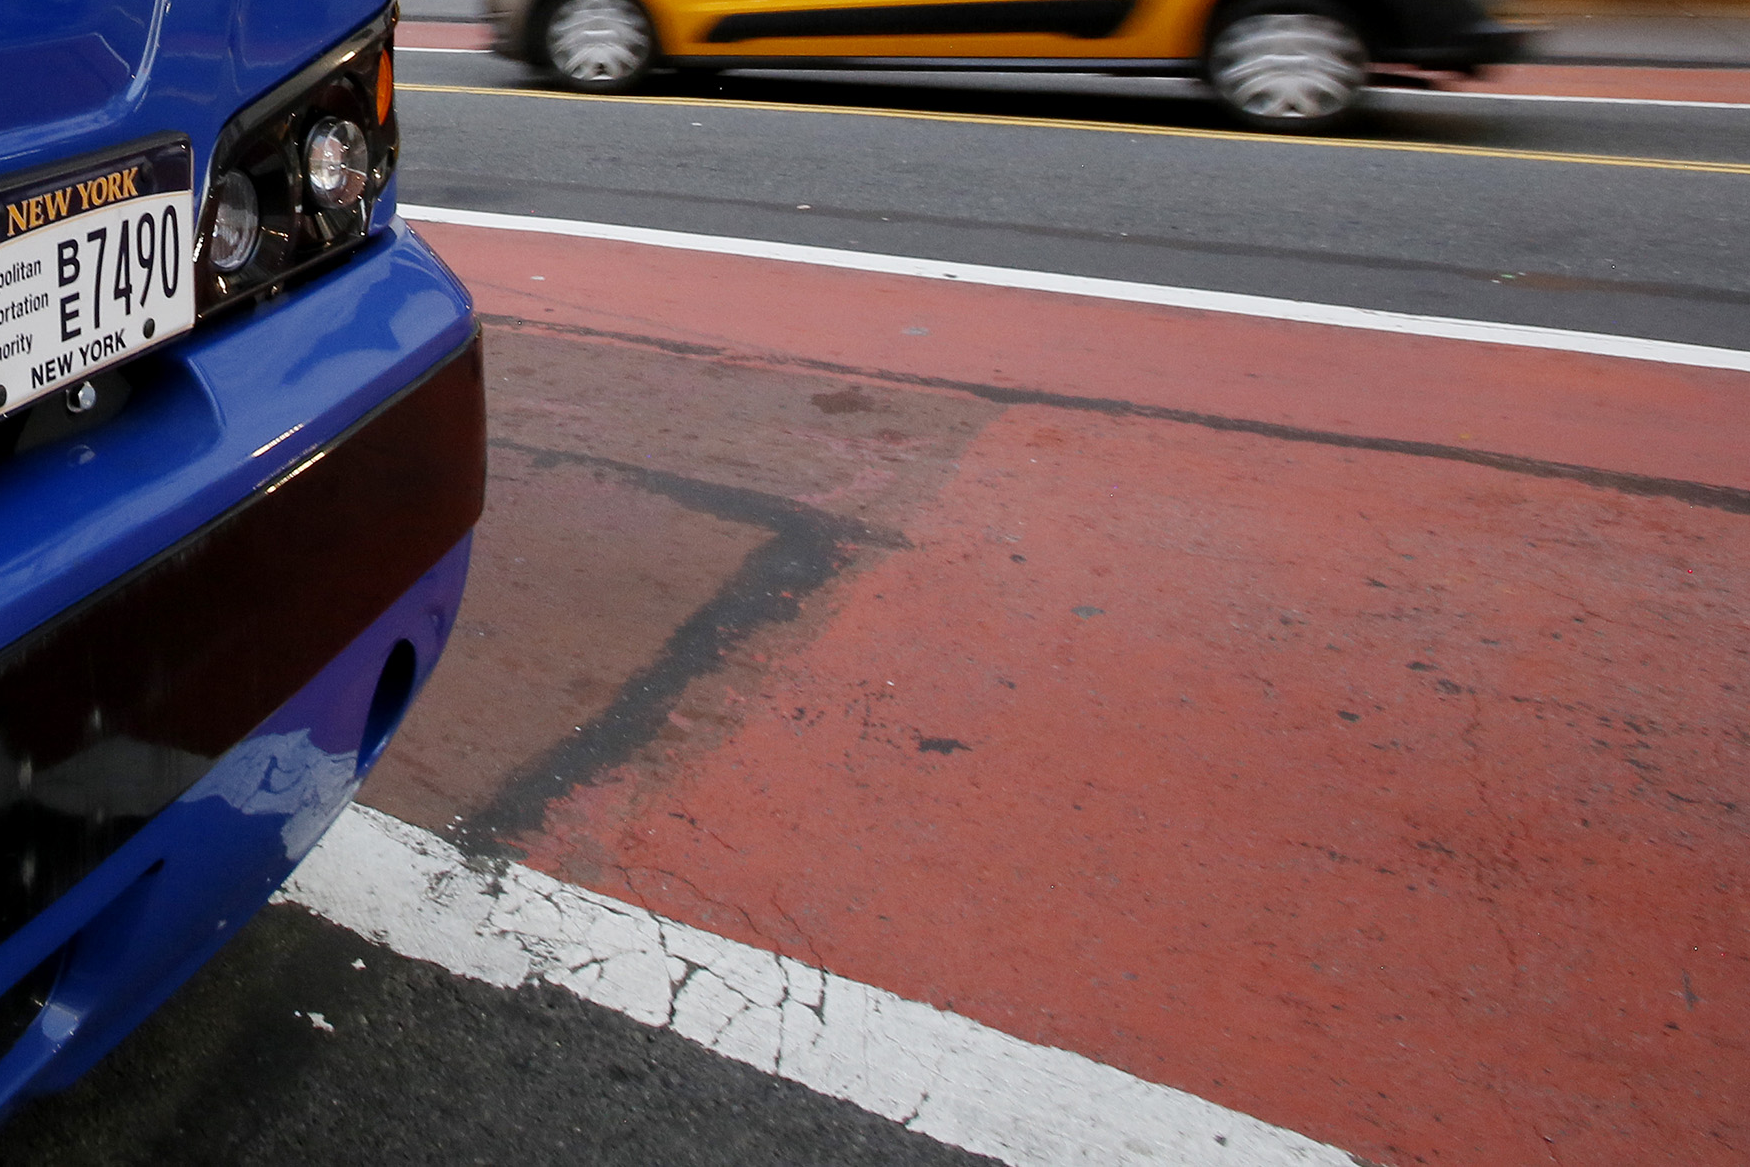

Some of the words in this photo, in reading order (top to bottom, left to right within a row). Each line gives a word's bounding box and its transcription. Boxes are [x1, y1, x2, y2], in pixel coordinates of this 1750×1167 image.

[6, 189, 72, 237] NEW
[76, 166, 139, 210] YORK
[86, 204, 181, 329] 7490
[30, 350, 74, 389] NEW
[78, 328, 127, 367] YORK
